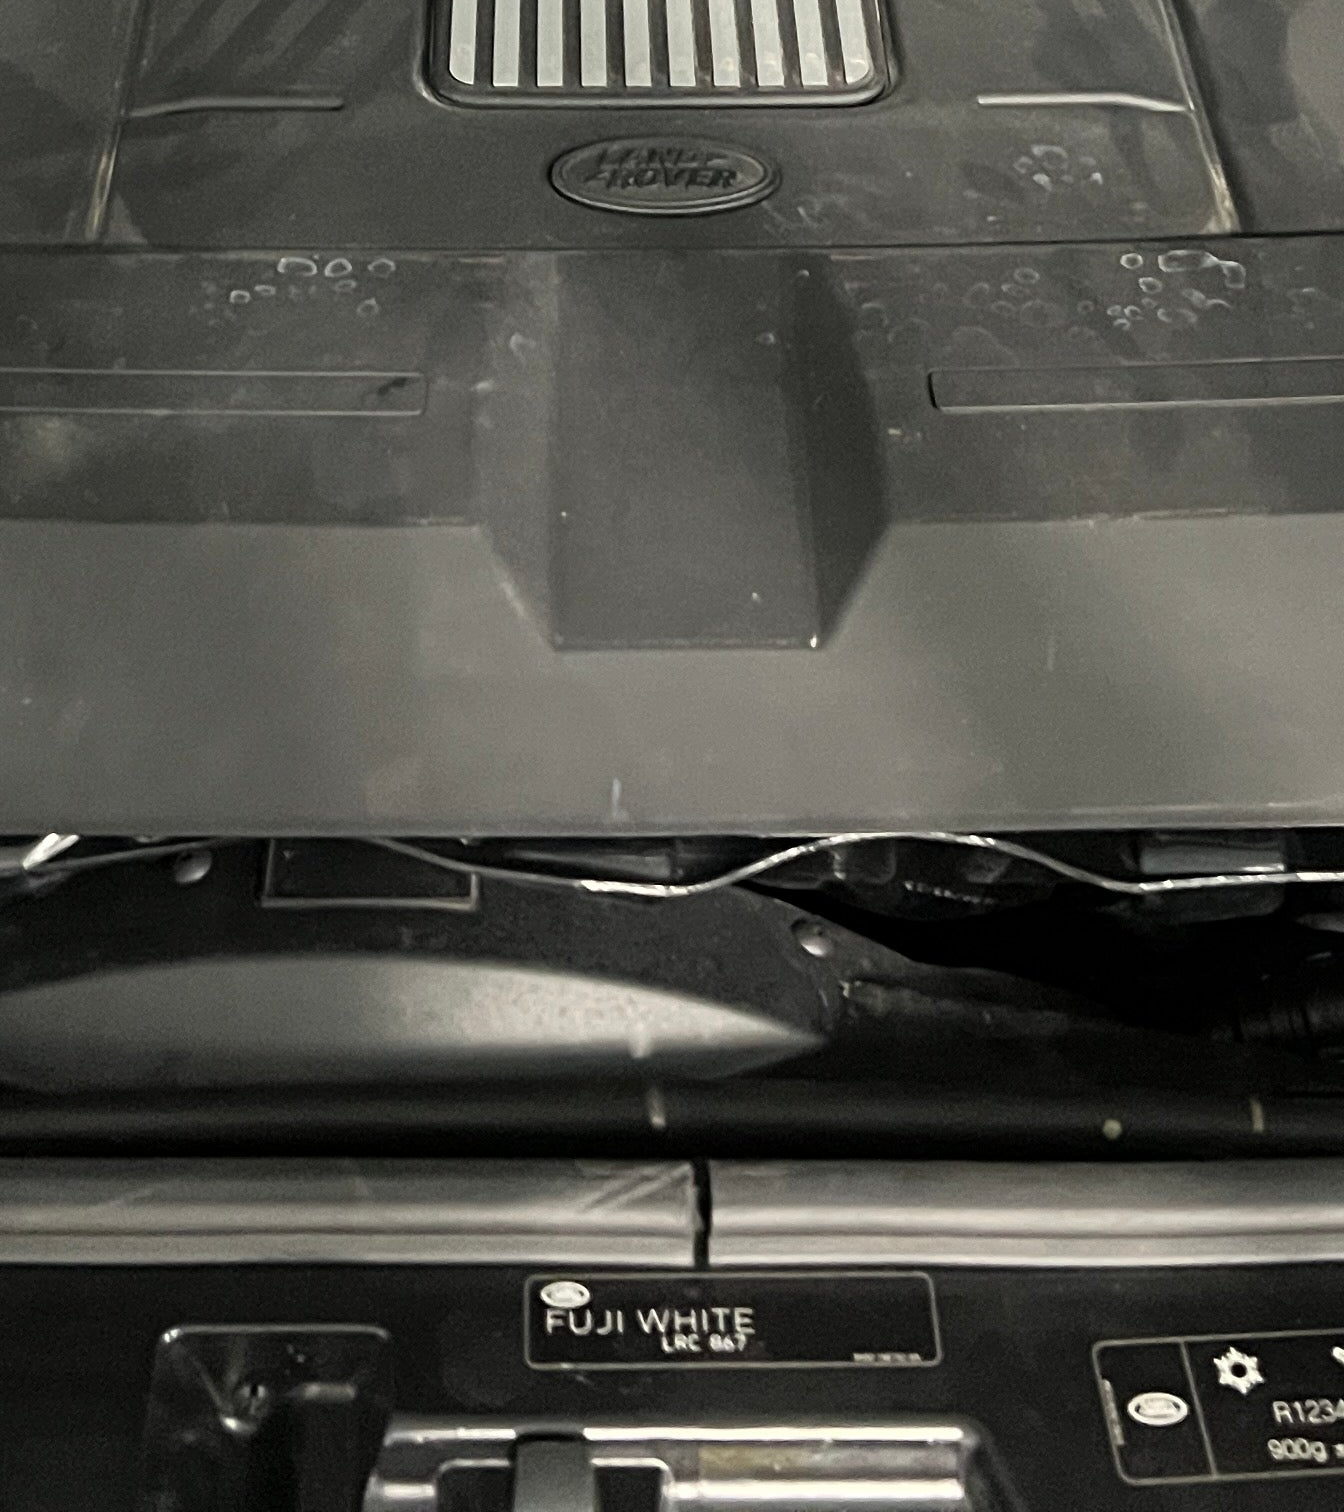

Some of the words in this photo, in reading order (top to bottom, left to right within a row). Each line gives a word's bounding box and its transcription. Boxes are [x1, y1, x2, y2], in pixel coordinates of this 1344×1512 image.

[605, 167, 738, 189] ROVER
[545, 1308, 624, 1335] FUJI
[636, 1306, 755, 1335] WHITE
[661, 1333, 701, 1353] LRC
[1267, 1438, 1329, 1463] 900g
